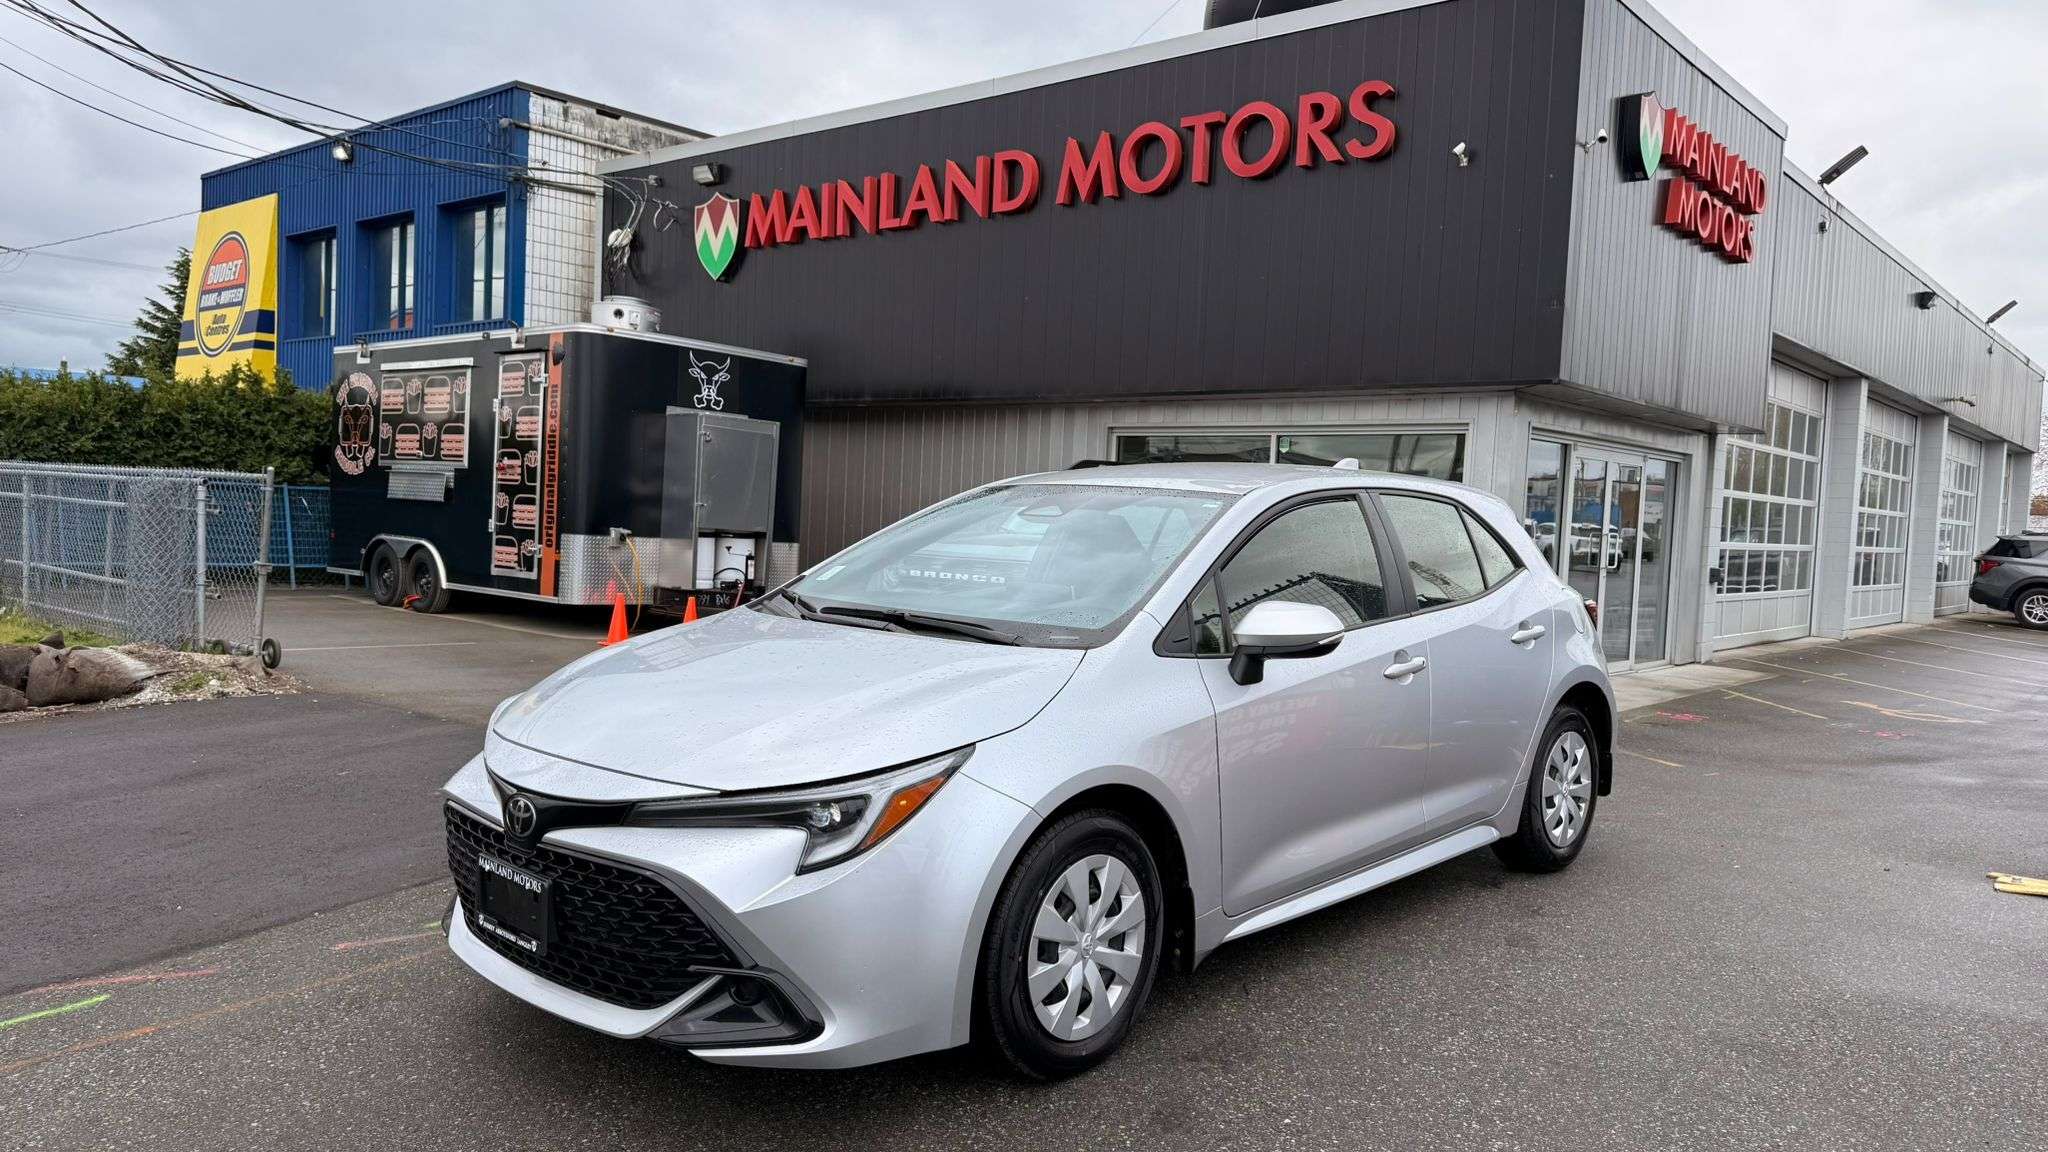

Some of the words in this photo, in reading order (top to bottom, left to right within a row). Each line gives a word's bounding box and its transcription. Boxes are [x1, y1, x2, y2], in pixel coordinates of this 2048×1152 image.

[744, 150, 1040, 248] MAINLAND
[1055, 80, 1397, 206] MOTORS
[1662, 107, 1768, 214] MAINLAND
[1665, 176, 1755, 263] MOTORS
[207, 259, 242, 285] BUDGET
[544, 384, 559, 548] originalgriddle.com
[910, 569, 1006, 584] BRONCO
[479, 856, 513, 880] MAINLAND
[513, 871, 542, 893] MOTORS
